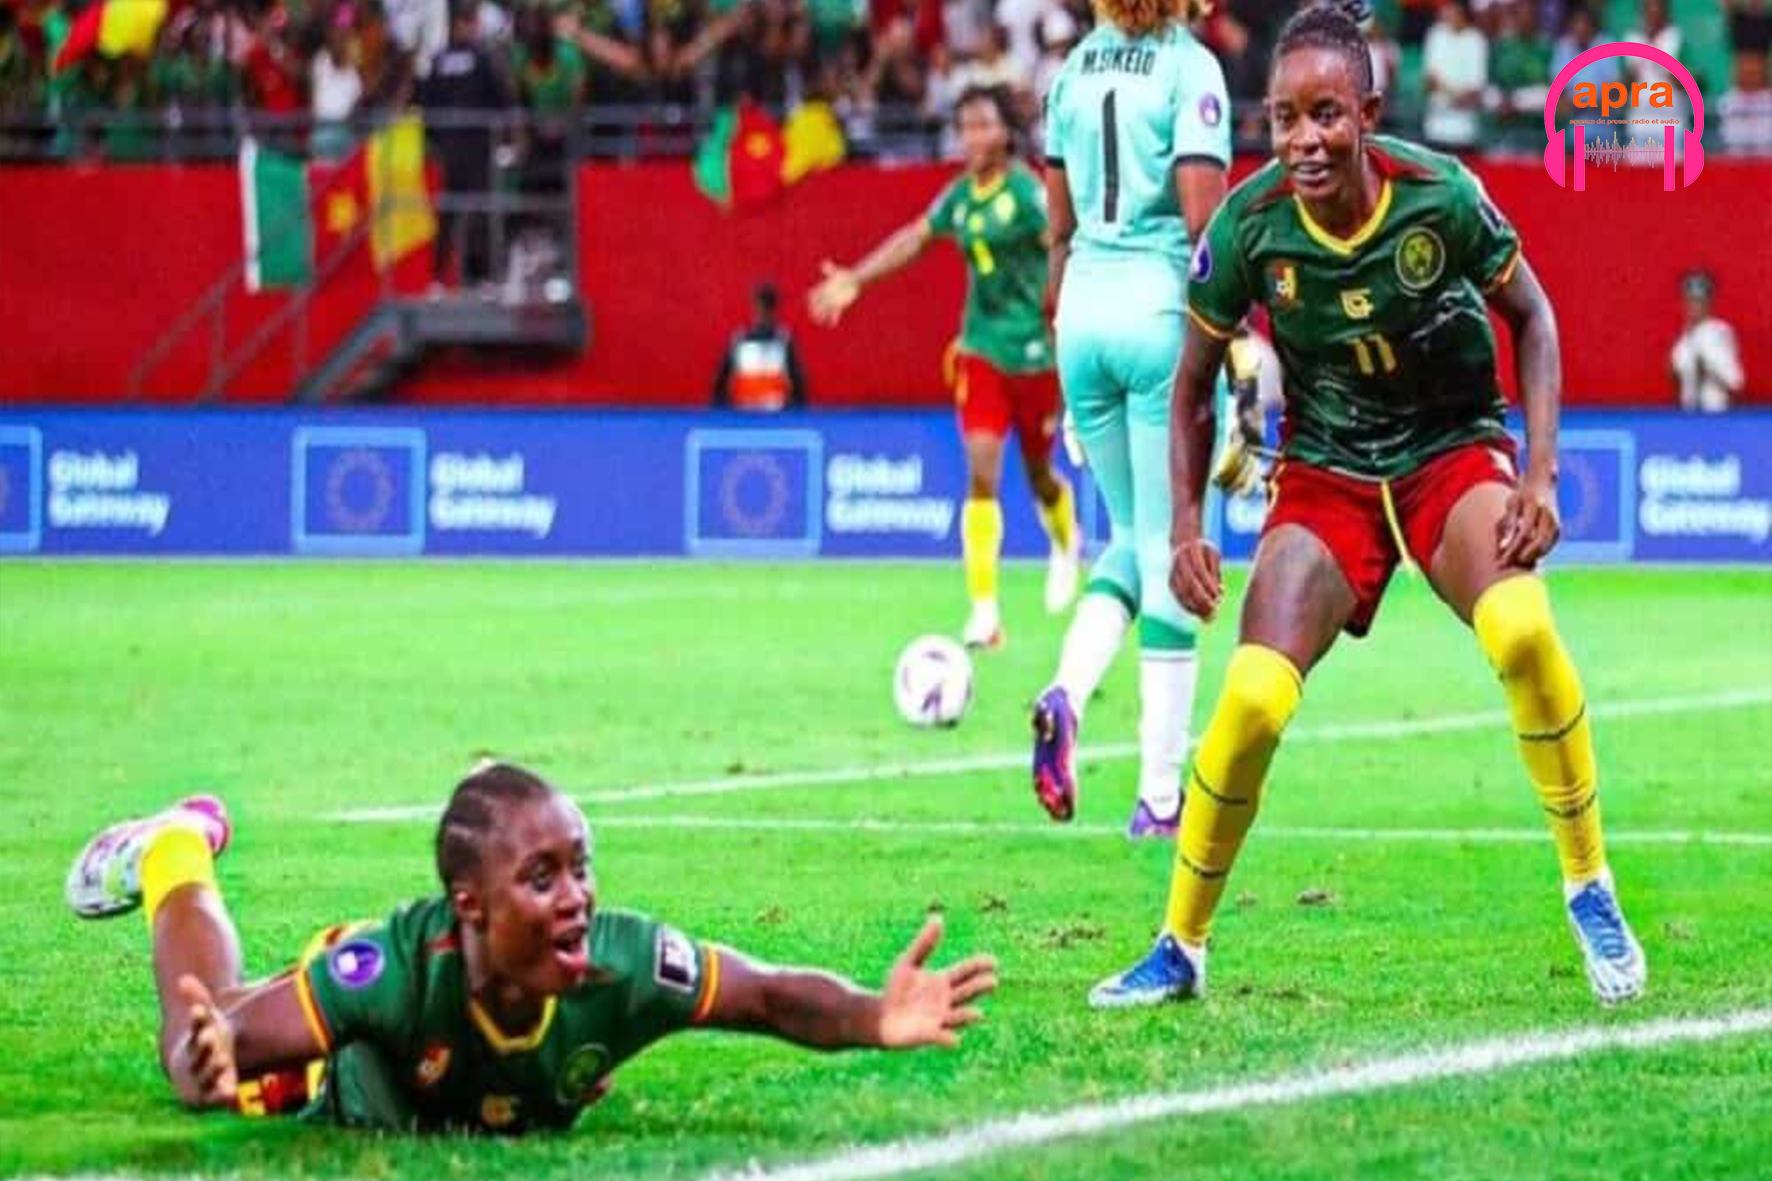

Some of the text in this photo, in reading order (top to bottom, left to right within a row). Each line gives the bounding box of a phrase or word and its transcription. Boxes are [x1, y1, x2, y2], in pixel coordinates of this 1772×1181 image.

[1103, 89, 1120, 222] 1
[1349, 334, 1397, 376] 11
[50, 454, 137, 489] Global
[432, 454, 524, 491] Global
[828, 455, 922, 492] Global
[1641, 455, 1741, 495] Global
